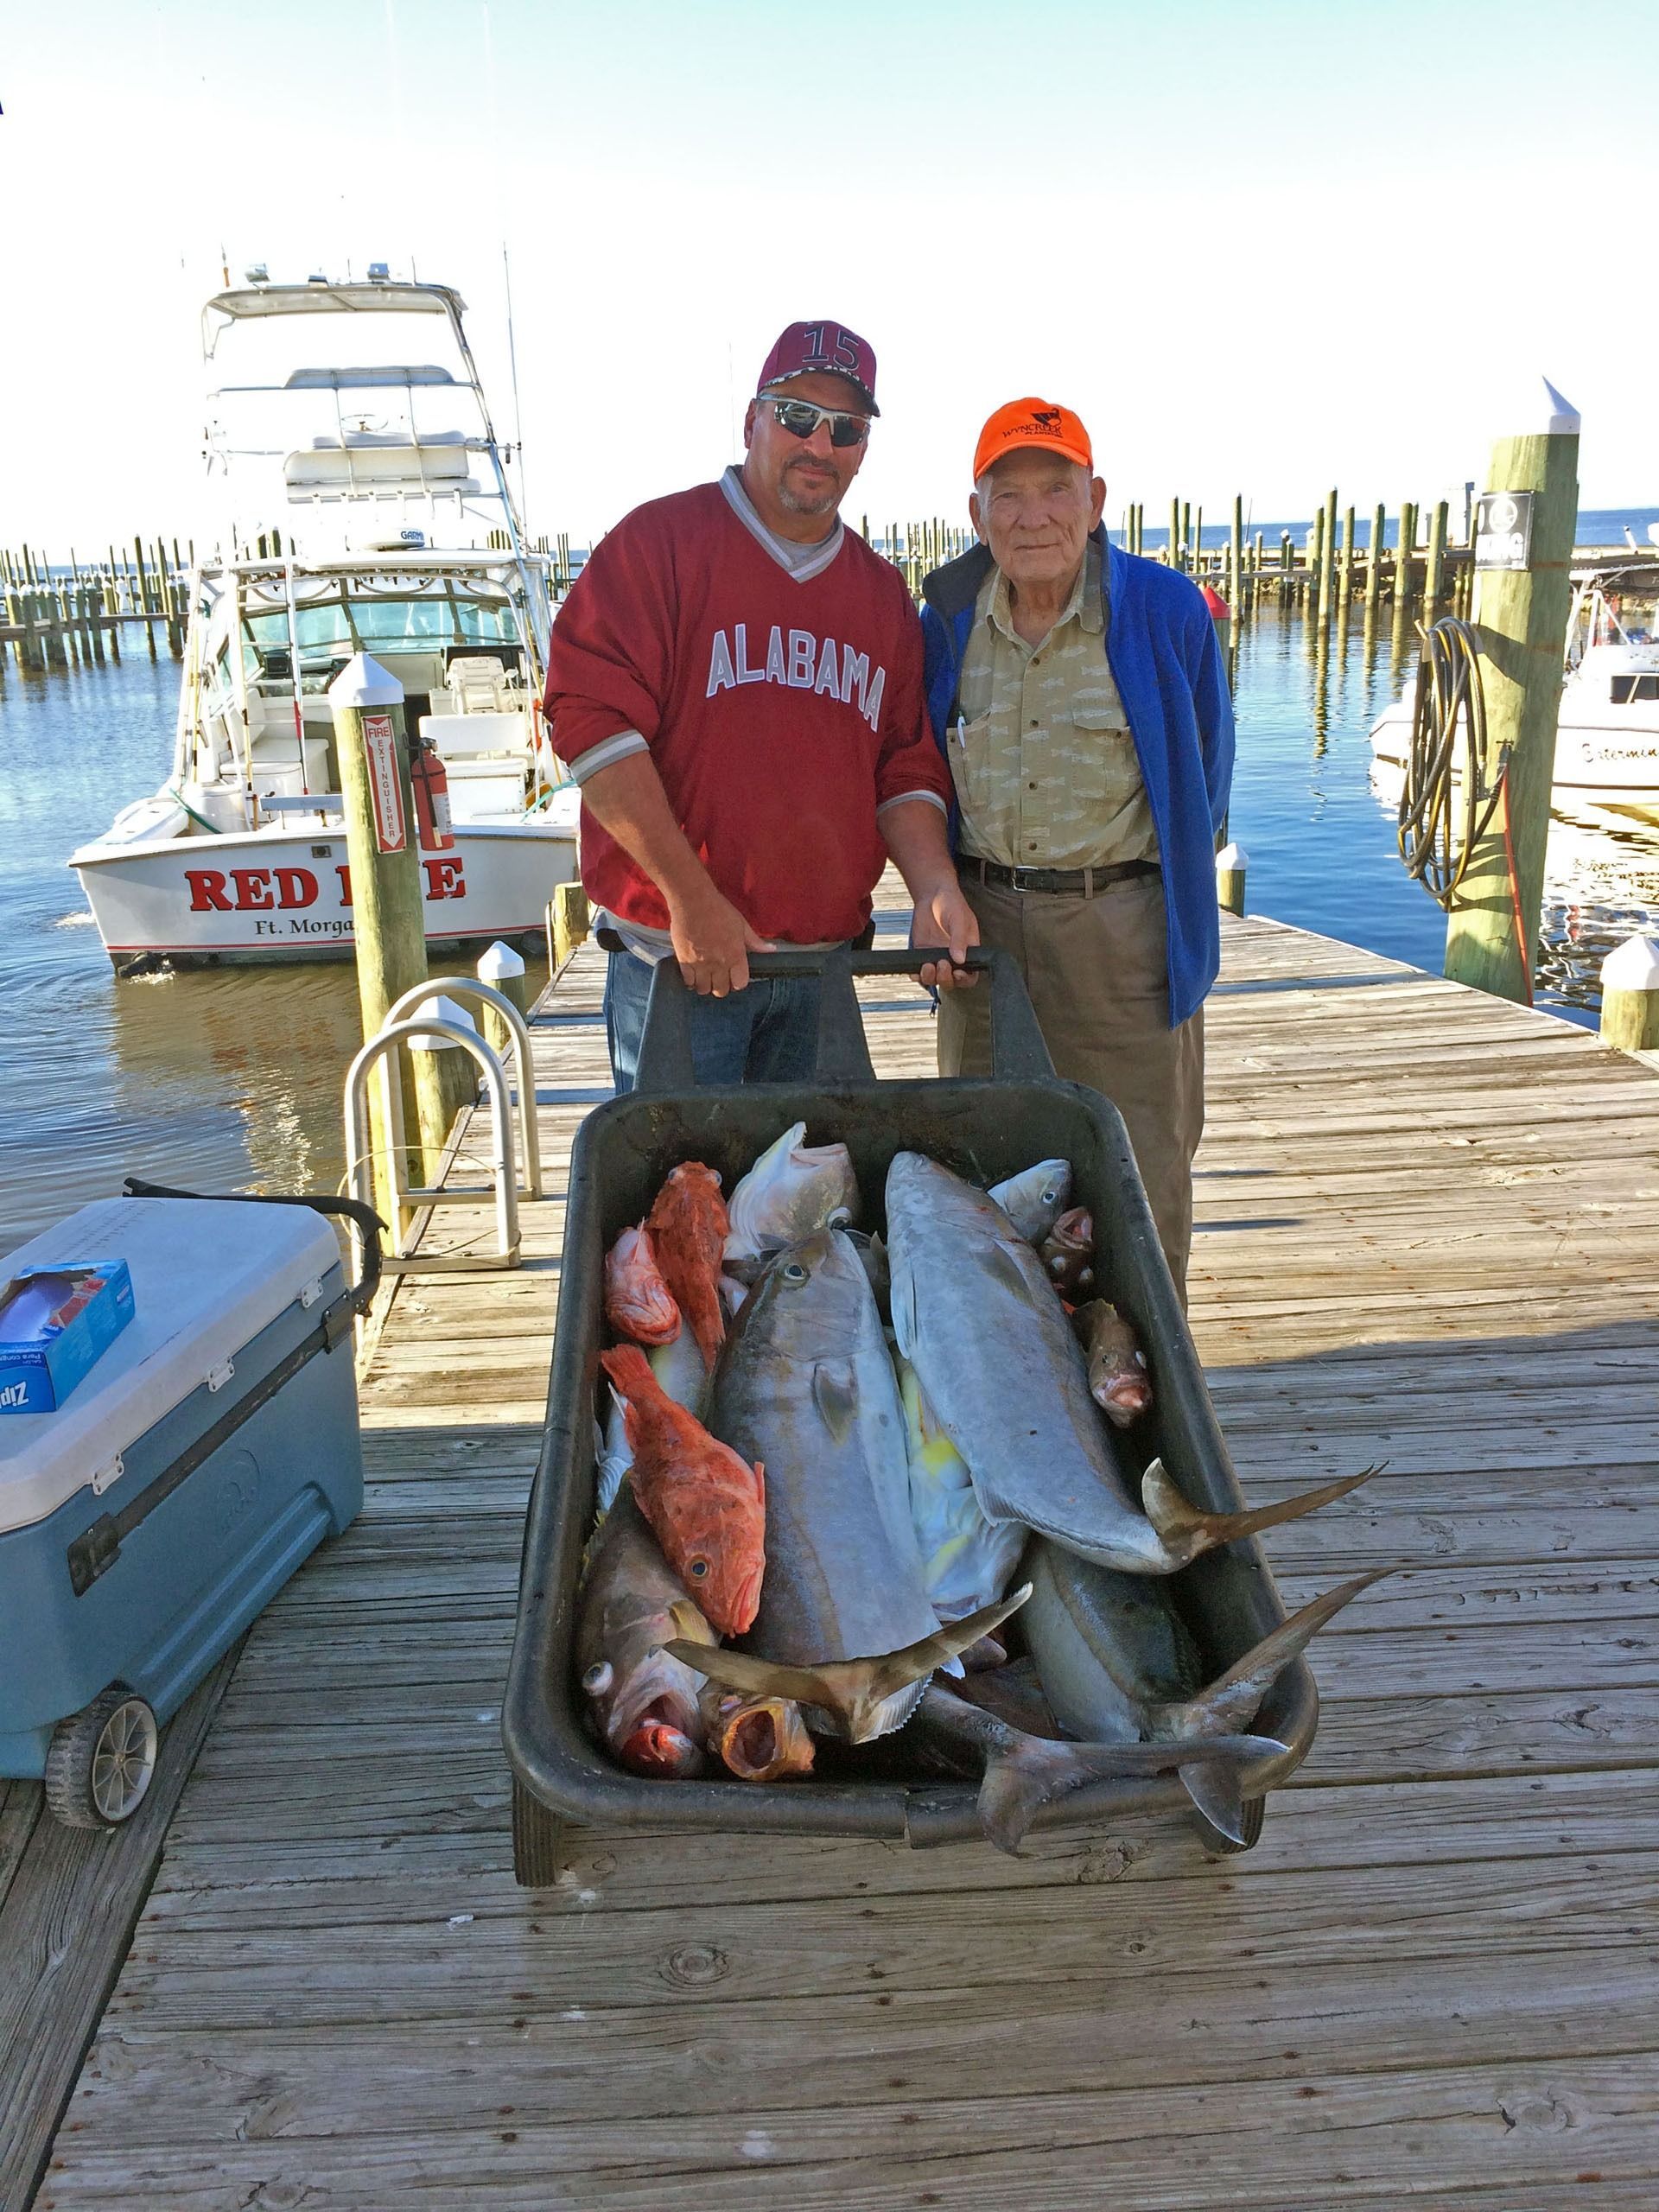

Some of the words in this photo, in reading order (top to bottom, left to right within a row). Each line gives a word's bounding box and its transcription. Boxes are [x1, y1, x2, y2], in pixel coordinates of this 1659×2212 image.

[802, 327, 859, 371] 15
[705, 623, 886, 733] ALABAMA
[369, 727, 391, 738] FIRE
[378, 740, 395, 837] EXTINGUISHER
[184, 867, 320, 912] RED
[255, 920, 283, 935] Ft.
[289, 918, 355, 938] Morga
